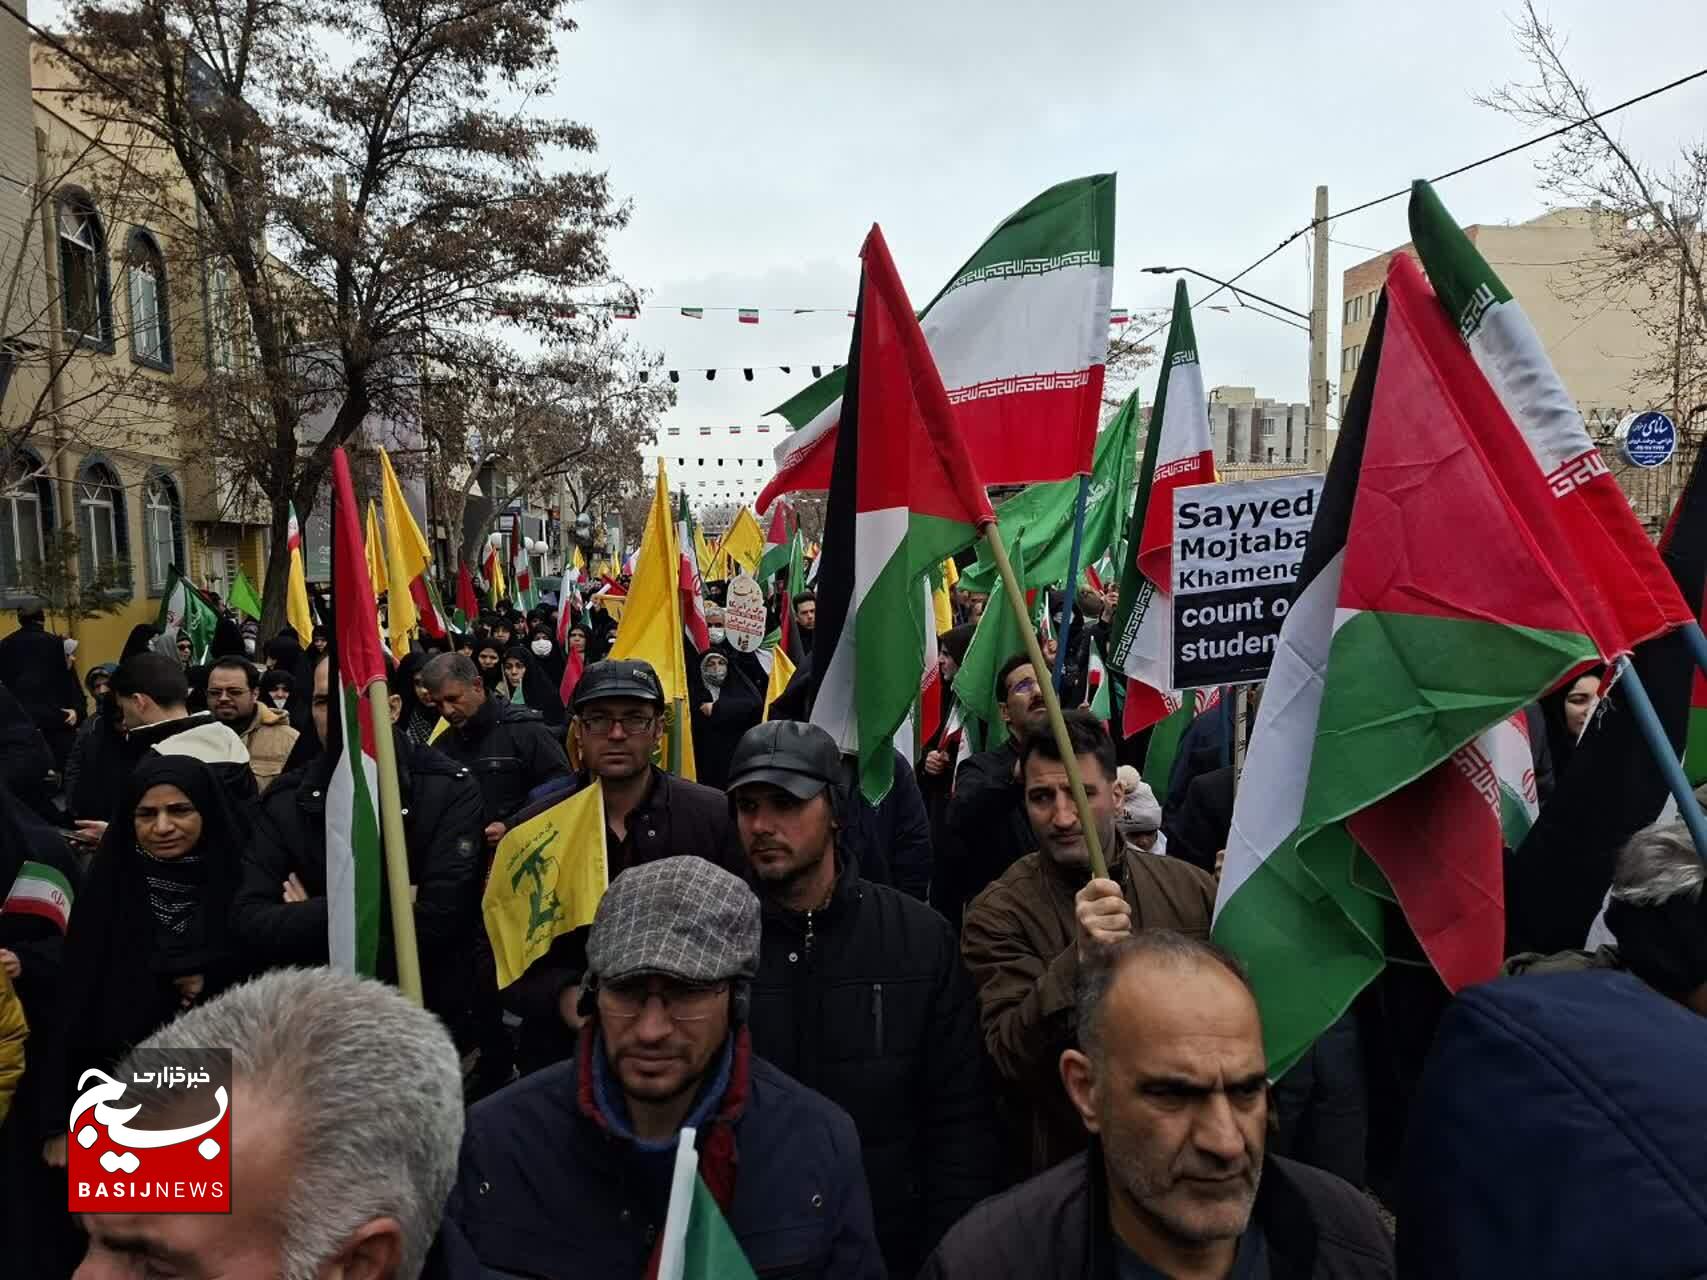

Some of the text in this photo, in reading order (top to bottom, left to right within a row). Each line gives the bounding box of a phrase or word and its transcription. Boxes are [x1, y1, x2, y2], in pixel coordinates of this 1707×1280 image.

[1177, 488, 1314, 531] Sayyed
[1180, 528, 1310, 562] Mojtaba
[1179, 562, 1303, 590] Khamene
[1181, 596, 1290, 628] count o
[1181, 631, 1280, 662] studen
